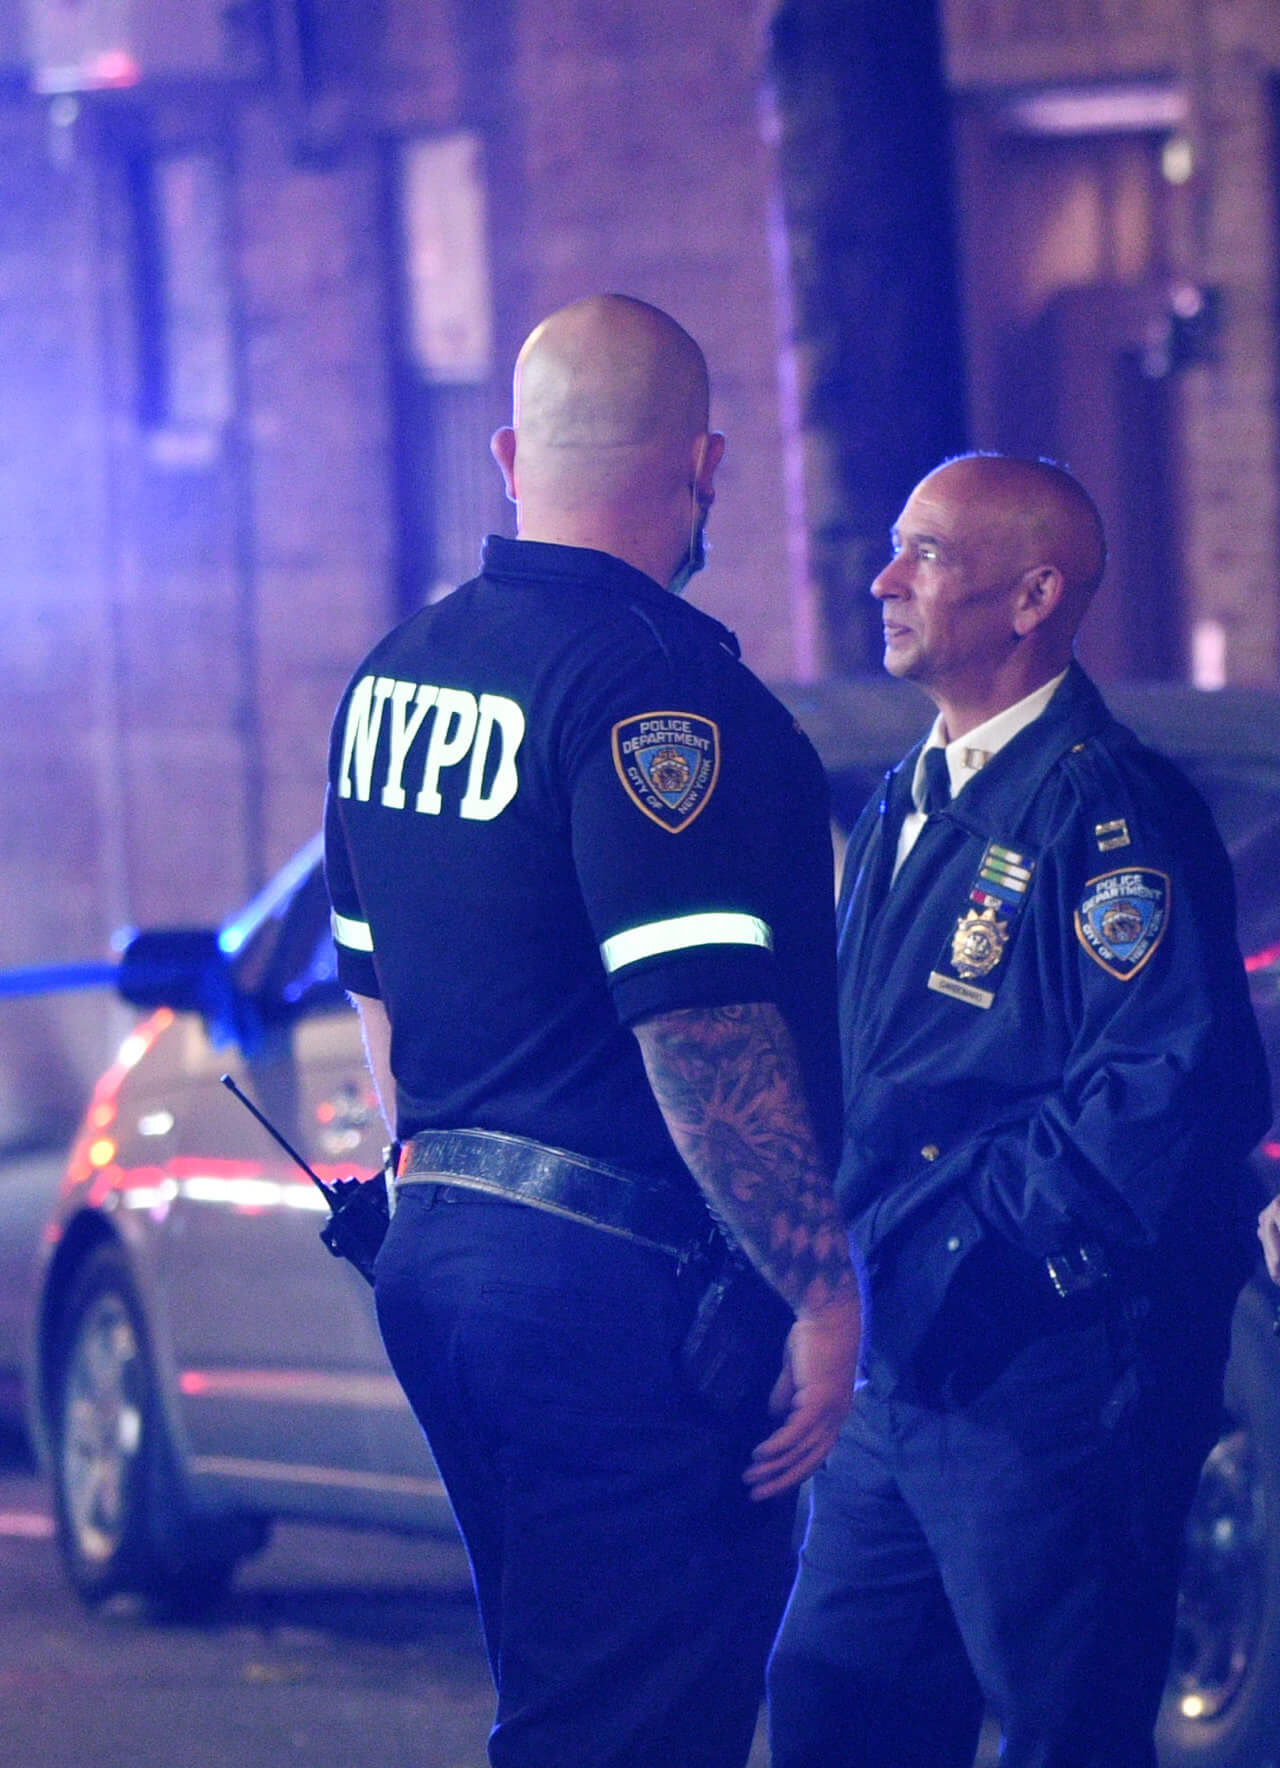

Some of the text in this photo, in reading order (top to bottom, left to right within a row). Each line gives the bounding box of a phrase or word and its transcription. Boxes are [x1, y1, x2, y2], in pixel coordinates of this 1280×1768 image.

[640, 720, 692, 734] POLICE
[338, 675, 526, 821] NYPD
[622, 732, 711, 754] DEPARTMENT
[627, 760, 712, 814] CITY OF NEW YORK
[1097, 875, 1142, 892] POLICE
[1083, 887, 1162, 913] DEPARTMENT
[1082, 924, 1101, 945] CITY
